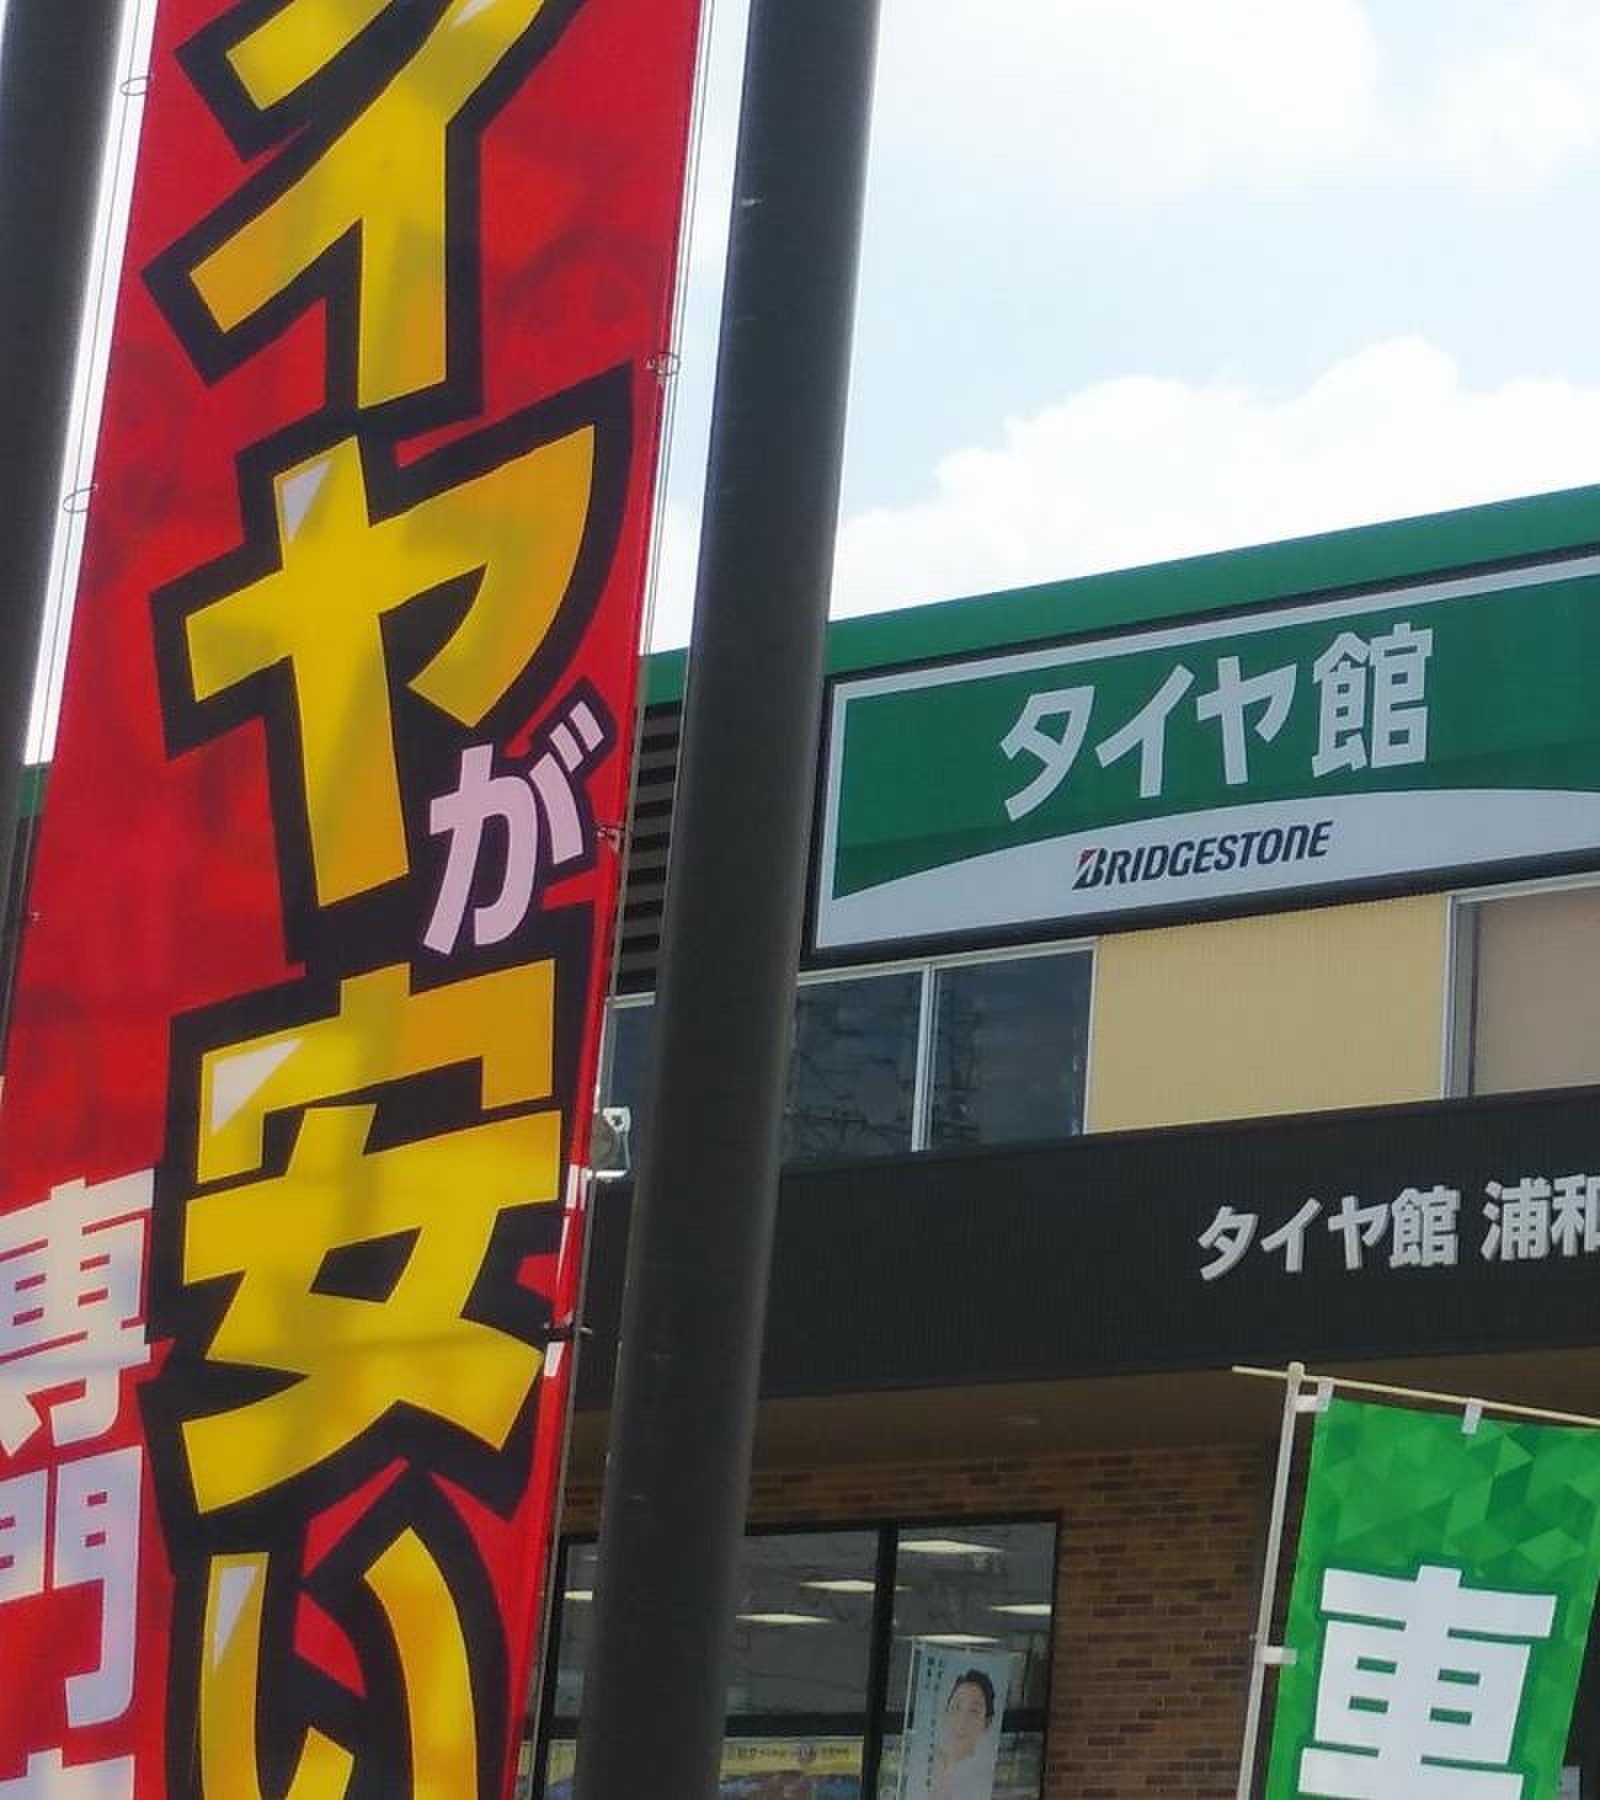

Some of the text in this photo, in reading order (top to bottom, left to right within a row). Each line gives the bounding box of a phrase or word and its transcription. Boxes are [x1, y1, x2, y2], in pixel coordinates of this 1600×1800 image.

[1000, 622, 1434, 821] タイヤ館
[1072, 820, 1334, 890] BRIDGESTONE
[1197, 1185, 1462, 1280] タイヤ館
[0, 1168, 155, 1800] 専門
[1298, 1564, 1558, 1800] 車
